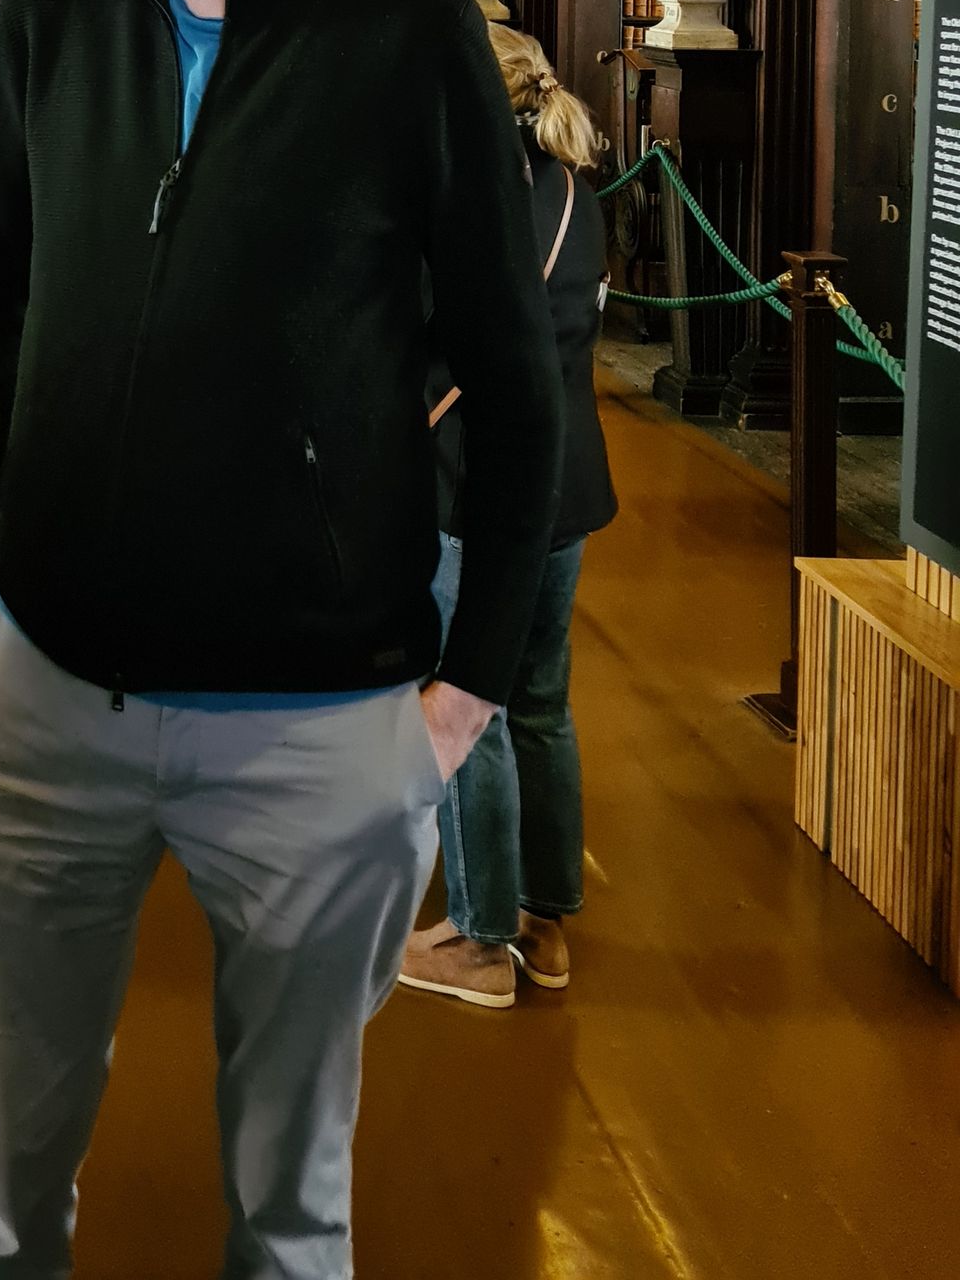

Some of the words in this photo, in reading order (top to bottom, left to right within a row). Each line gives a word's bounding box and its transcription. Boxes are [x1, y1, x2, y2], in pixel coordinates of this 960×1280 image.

[882, 94, 897, 113] c
[597, 132, 610, 151] b
[879, 196, 899, 223] b
[878, 321, 893, 339] a
